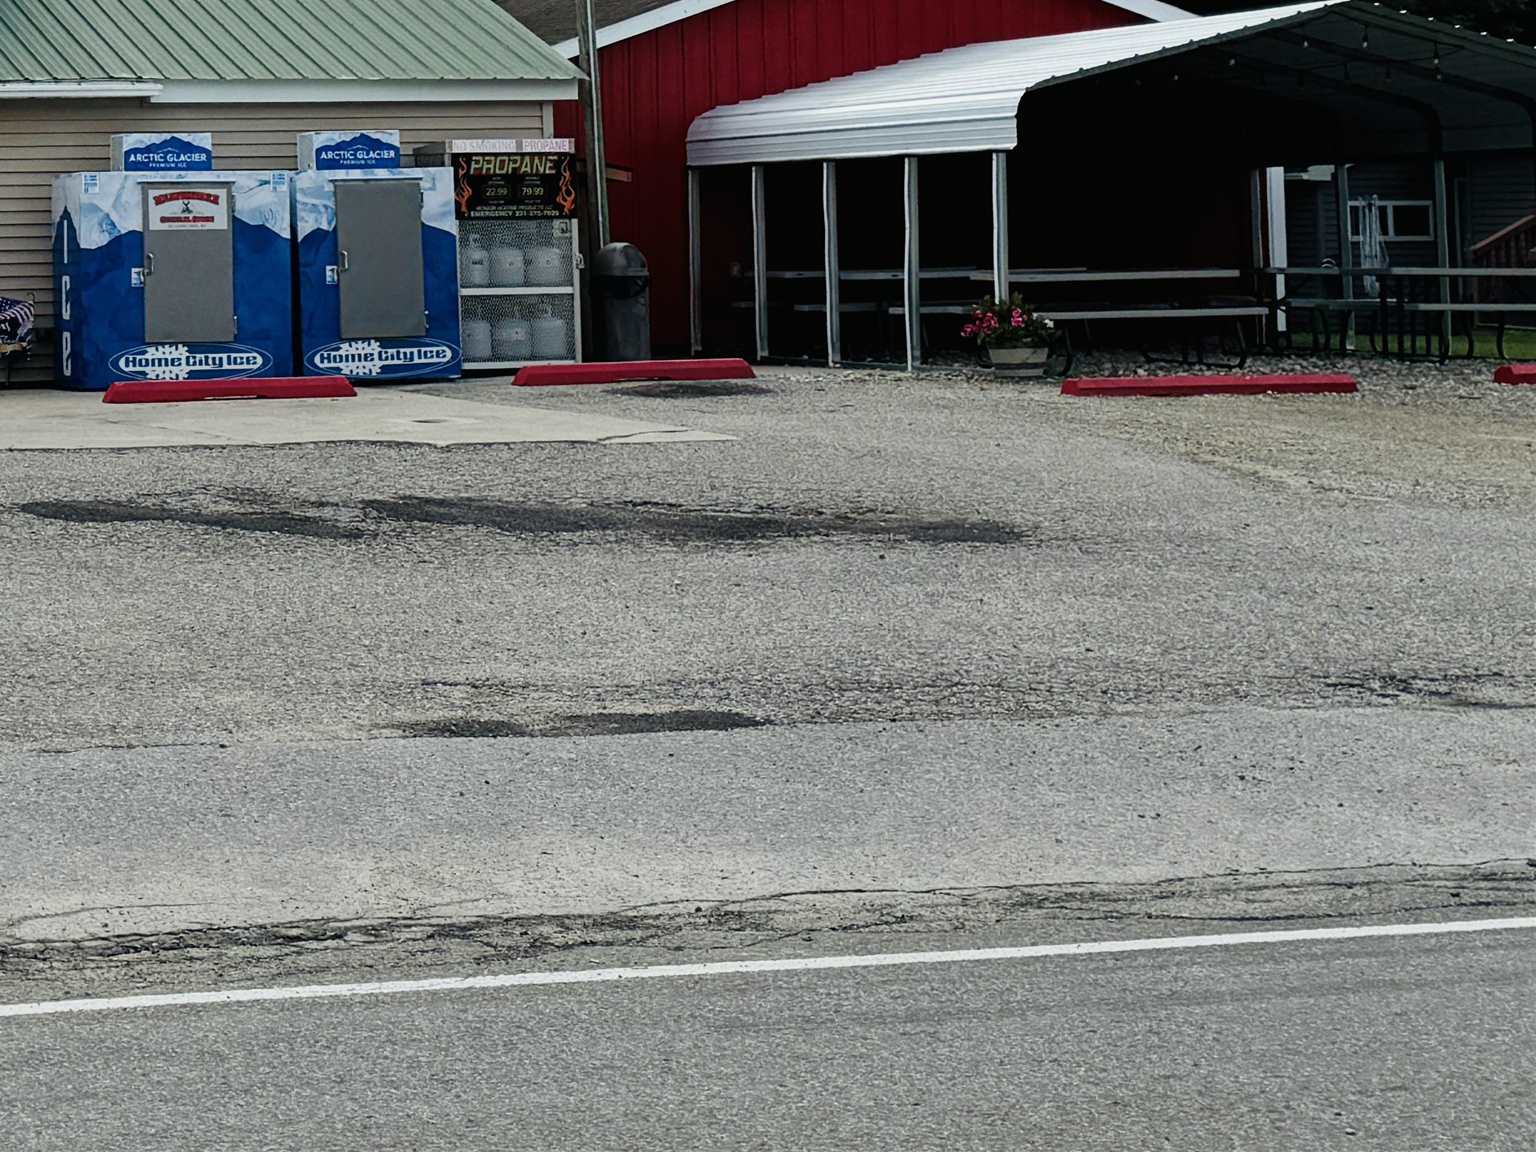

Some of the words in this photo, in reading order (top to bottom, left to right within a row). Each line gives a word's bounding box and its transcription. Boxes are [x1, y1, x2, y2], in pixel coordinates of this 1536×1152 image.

[129, 153, 164, 162] ARCTIC
[166, 153, 207, 162] GLACIER
[320, 151, 354, 159] ARCTIC
[356, 150, 395, 159] GLACIER
[470, 156, 558, 174] PROPANE
[124, 355, 182, 368] Home
[185, 355, 224, 368] City
[226, 354, 257, 366] Ice
[319, 352, 375, 364] Home
[378, 350, 413, 363] City
[417, 349, 447, 359] Ice
